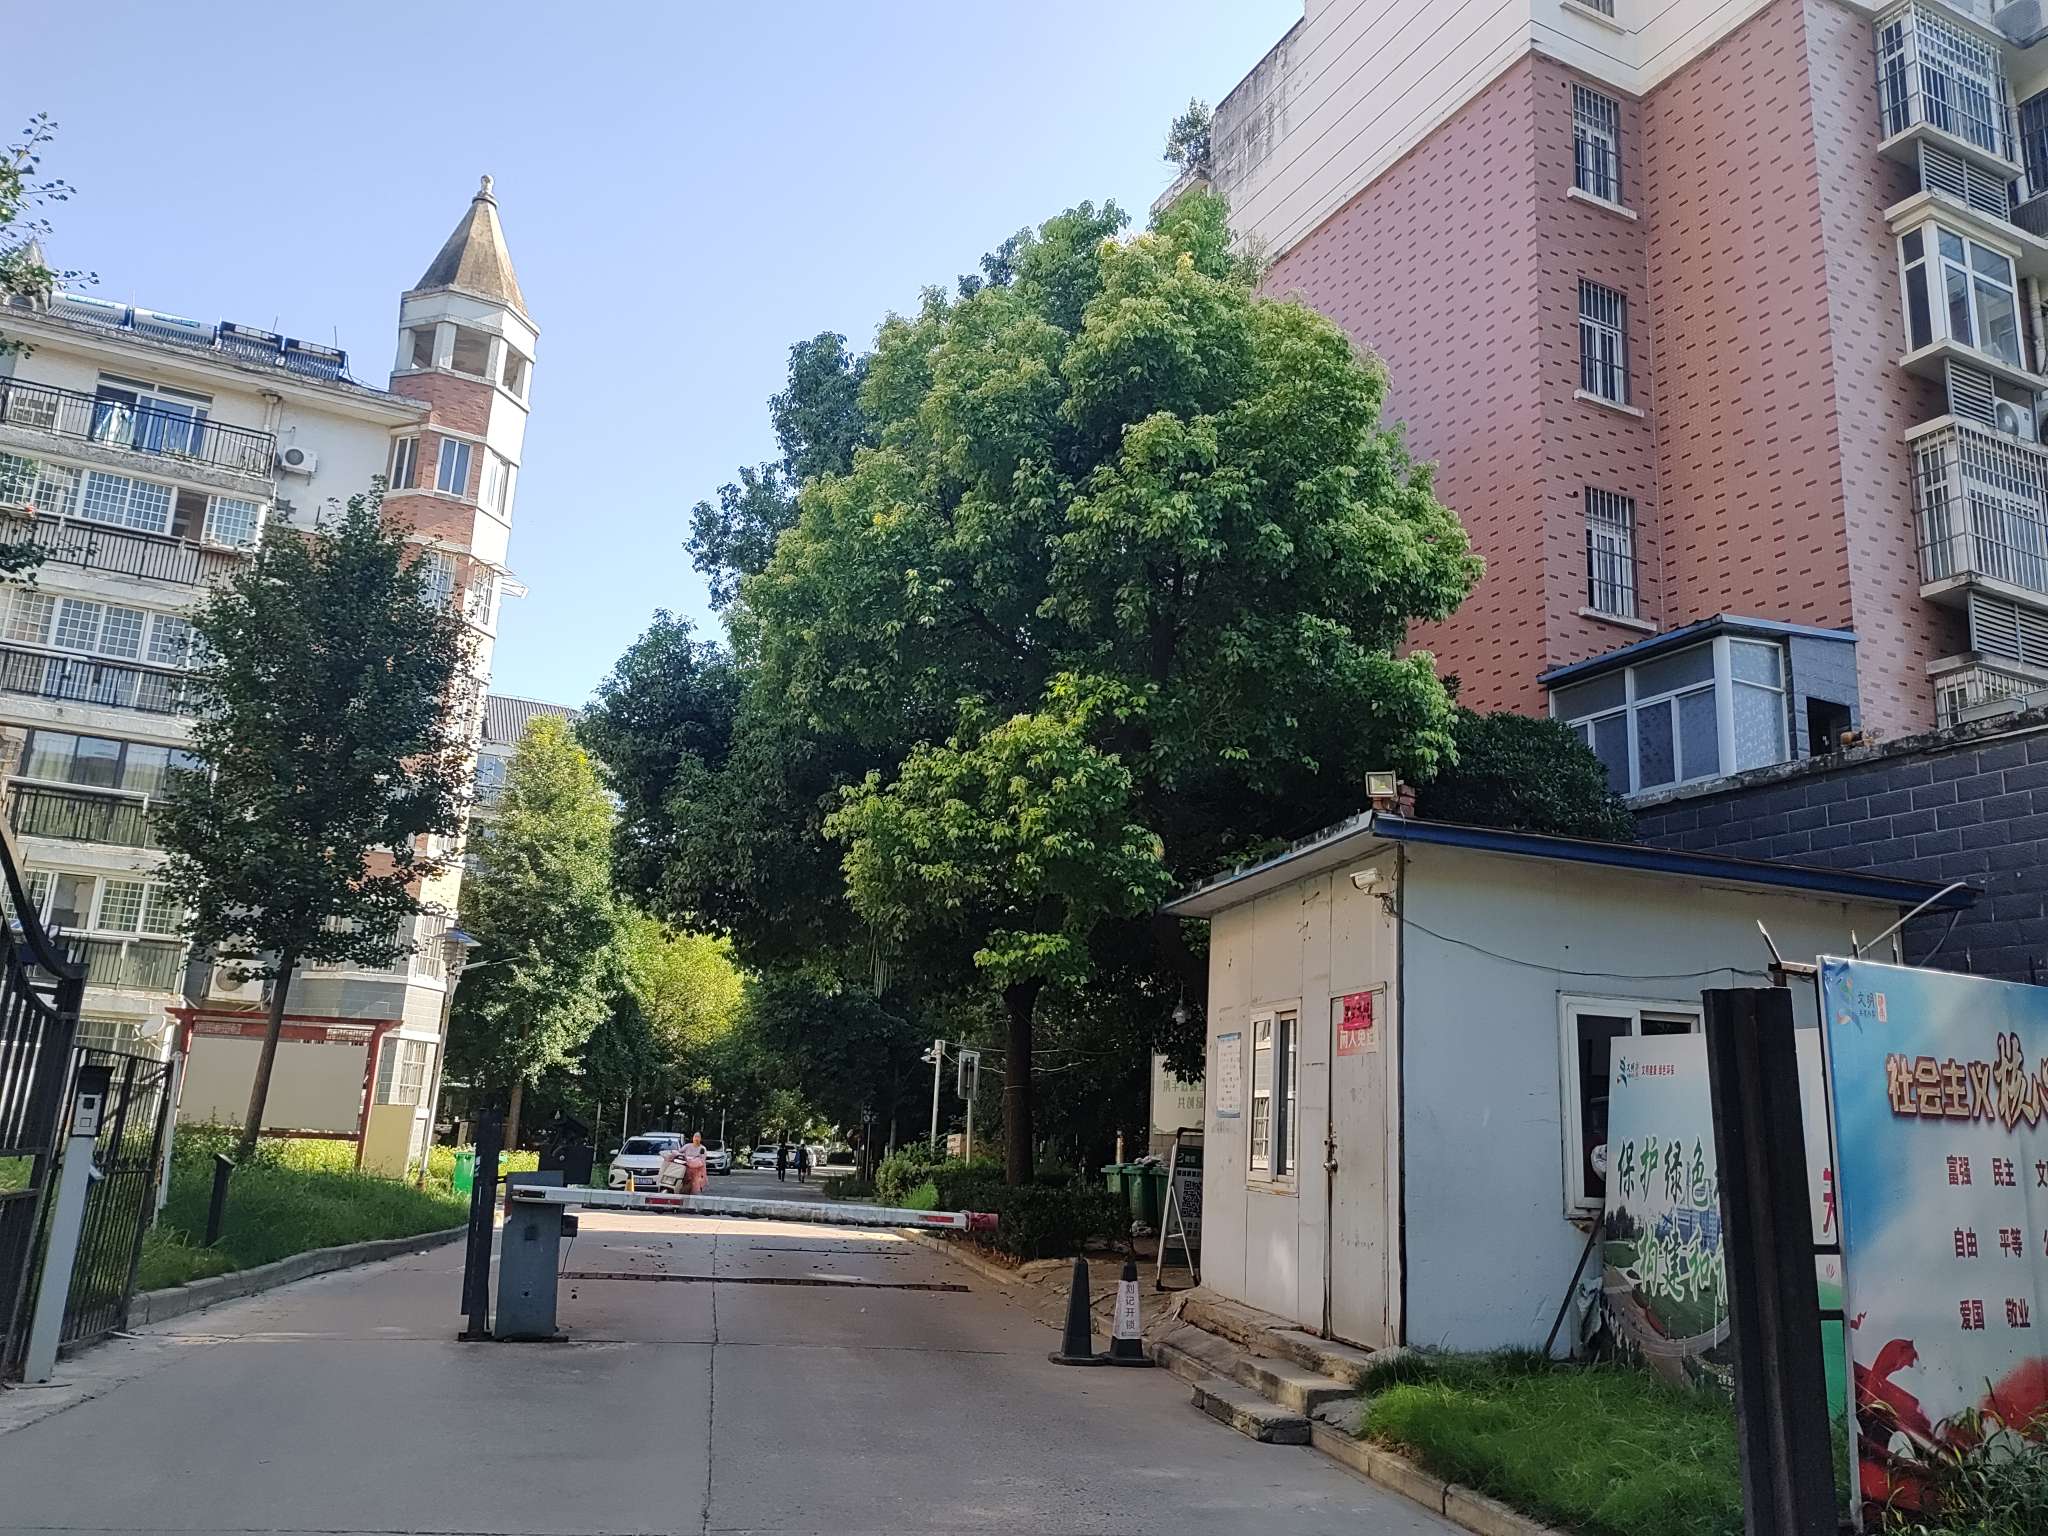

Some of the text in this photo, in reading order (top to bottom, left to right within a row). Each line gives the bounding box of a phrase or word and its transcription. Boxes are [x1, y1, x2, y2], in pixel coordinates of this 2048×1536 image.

[1616, 1134, 1720, 1210] 保护绿色
[1946, 1155, 2048, 1188] 富强 民主 文
[1954, 1227, 1978, 1258] 自由
[1999, 1227, 2023, 1258] 平等
[1960, 1298, 2030, 1330] 爱国 敬业
